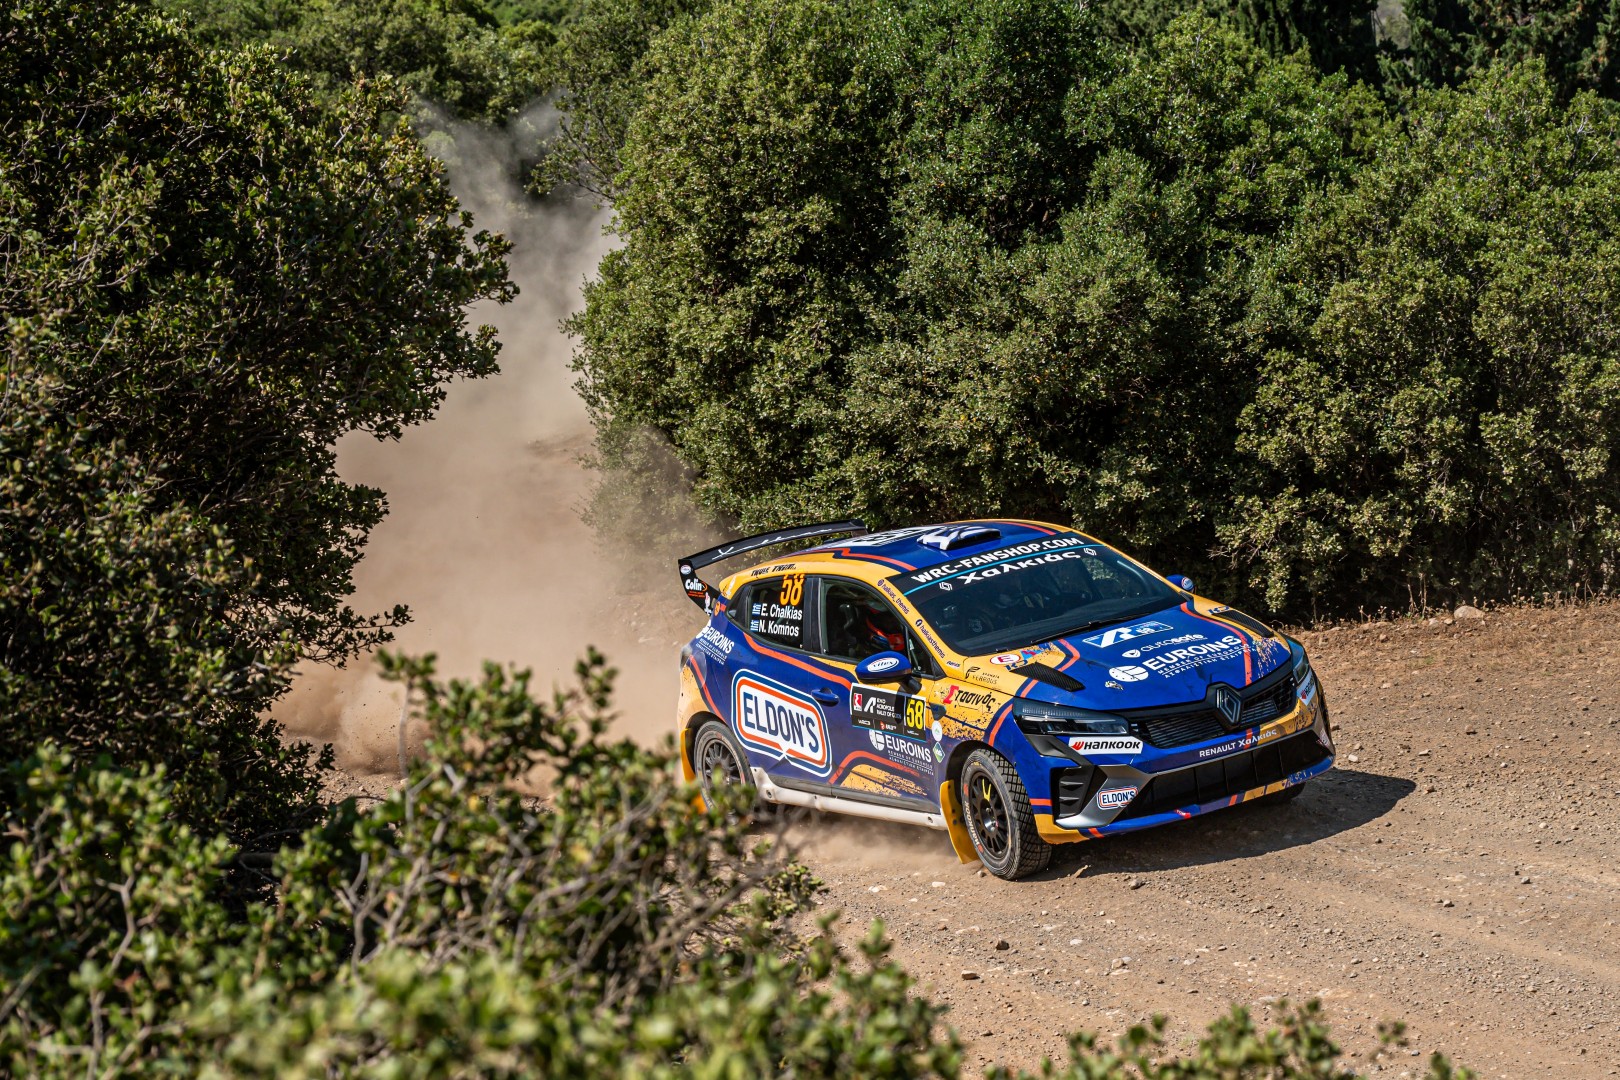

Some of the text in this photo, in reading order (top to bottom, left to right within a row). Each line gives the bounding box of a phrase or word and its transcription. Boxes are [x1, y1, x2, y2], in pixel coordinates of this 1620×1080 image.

[910, 537, 1084, 583] WRC-FANSHOP.COM
[780, 573, 805, 606] 58
[761, 603, 802, 620] E. Chalkias
[703, 627, 734, 653] EUROINS
[758, 619, 799, 637] N. Komnos
[1142, 635, 1242, 671] EUROINS
[943, 685, 996, 712] Στασινός
[743, 692, 819, 753] ELDON'S
[906, 698, 924, 730] 58
[885, 735, 932, 763] EUROINS
[1199, 742, 1236, 758] RENAULT
[1102, 791, 1134, 804] ELDON'S
